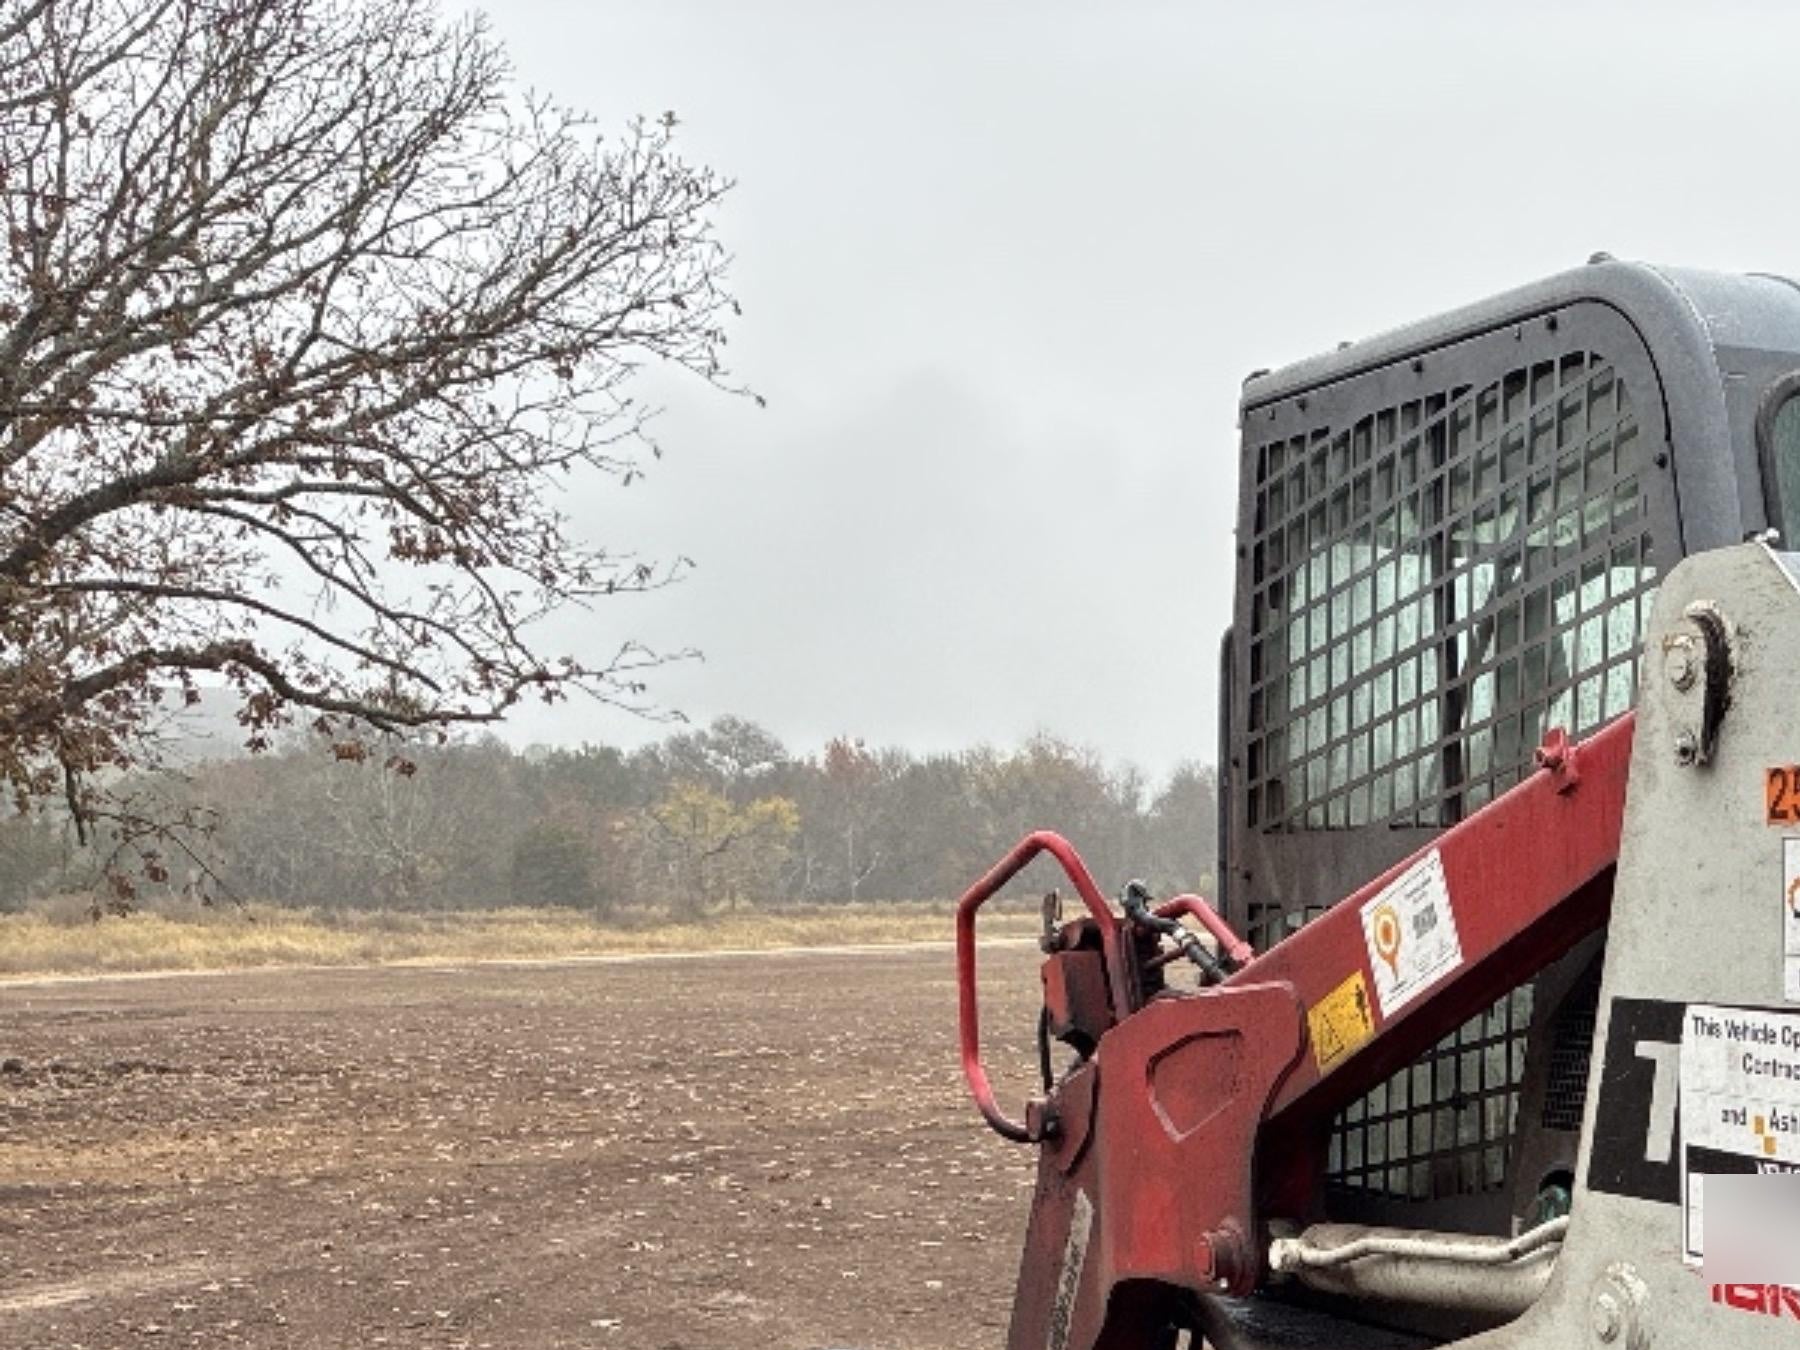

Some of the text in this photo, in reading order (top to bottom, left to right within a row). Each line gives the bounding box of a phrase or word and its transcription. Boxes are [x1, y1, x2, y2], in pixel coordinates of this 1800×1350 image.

[1692, 1015, 1721, 1039] This
[1723, 1018, 1777, 1046] Vehicle
[1721, 1106, 1747, 1127] and
